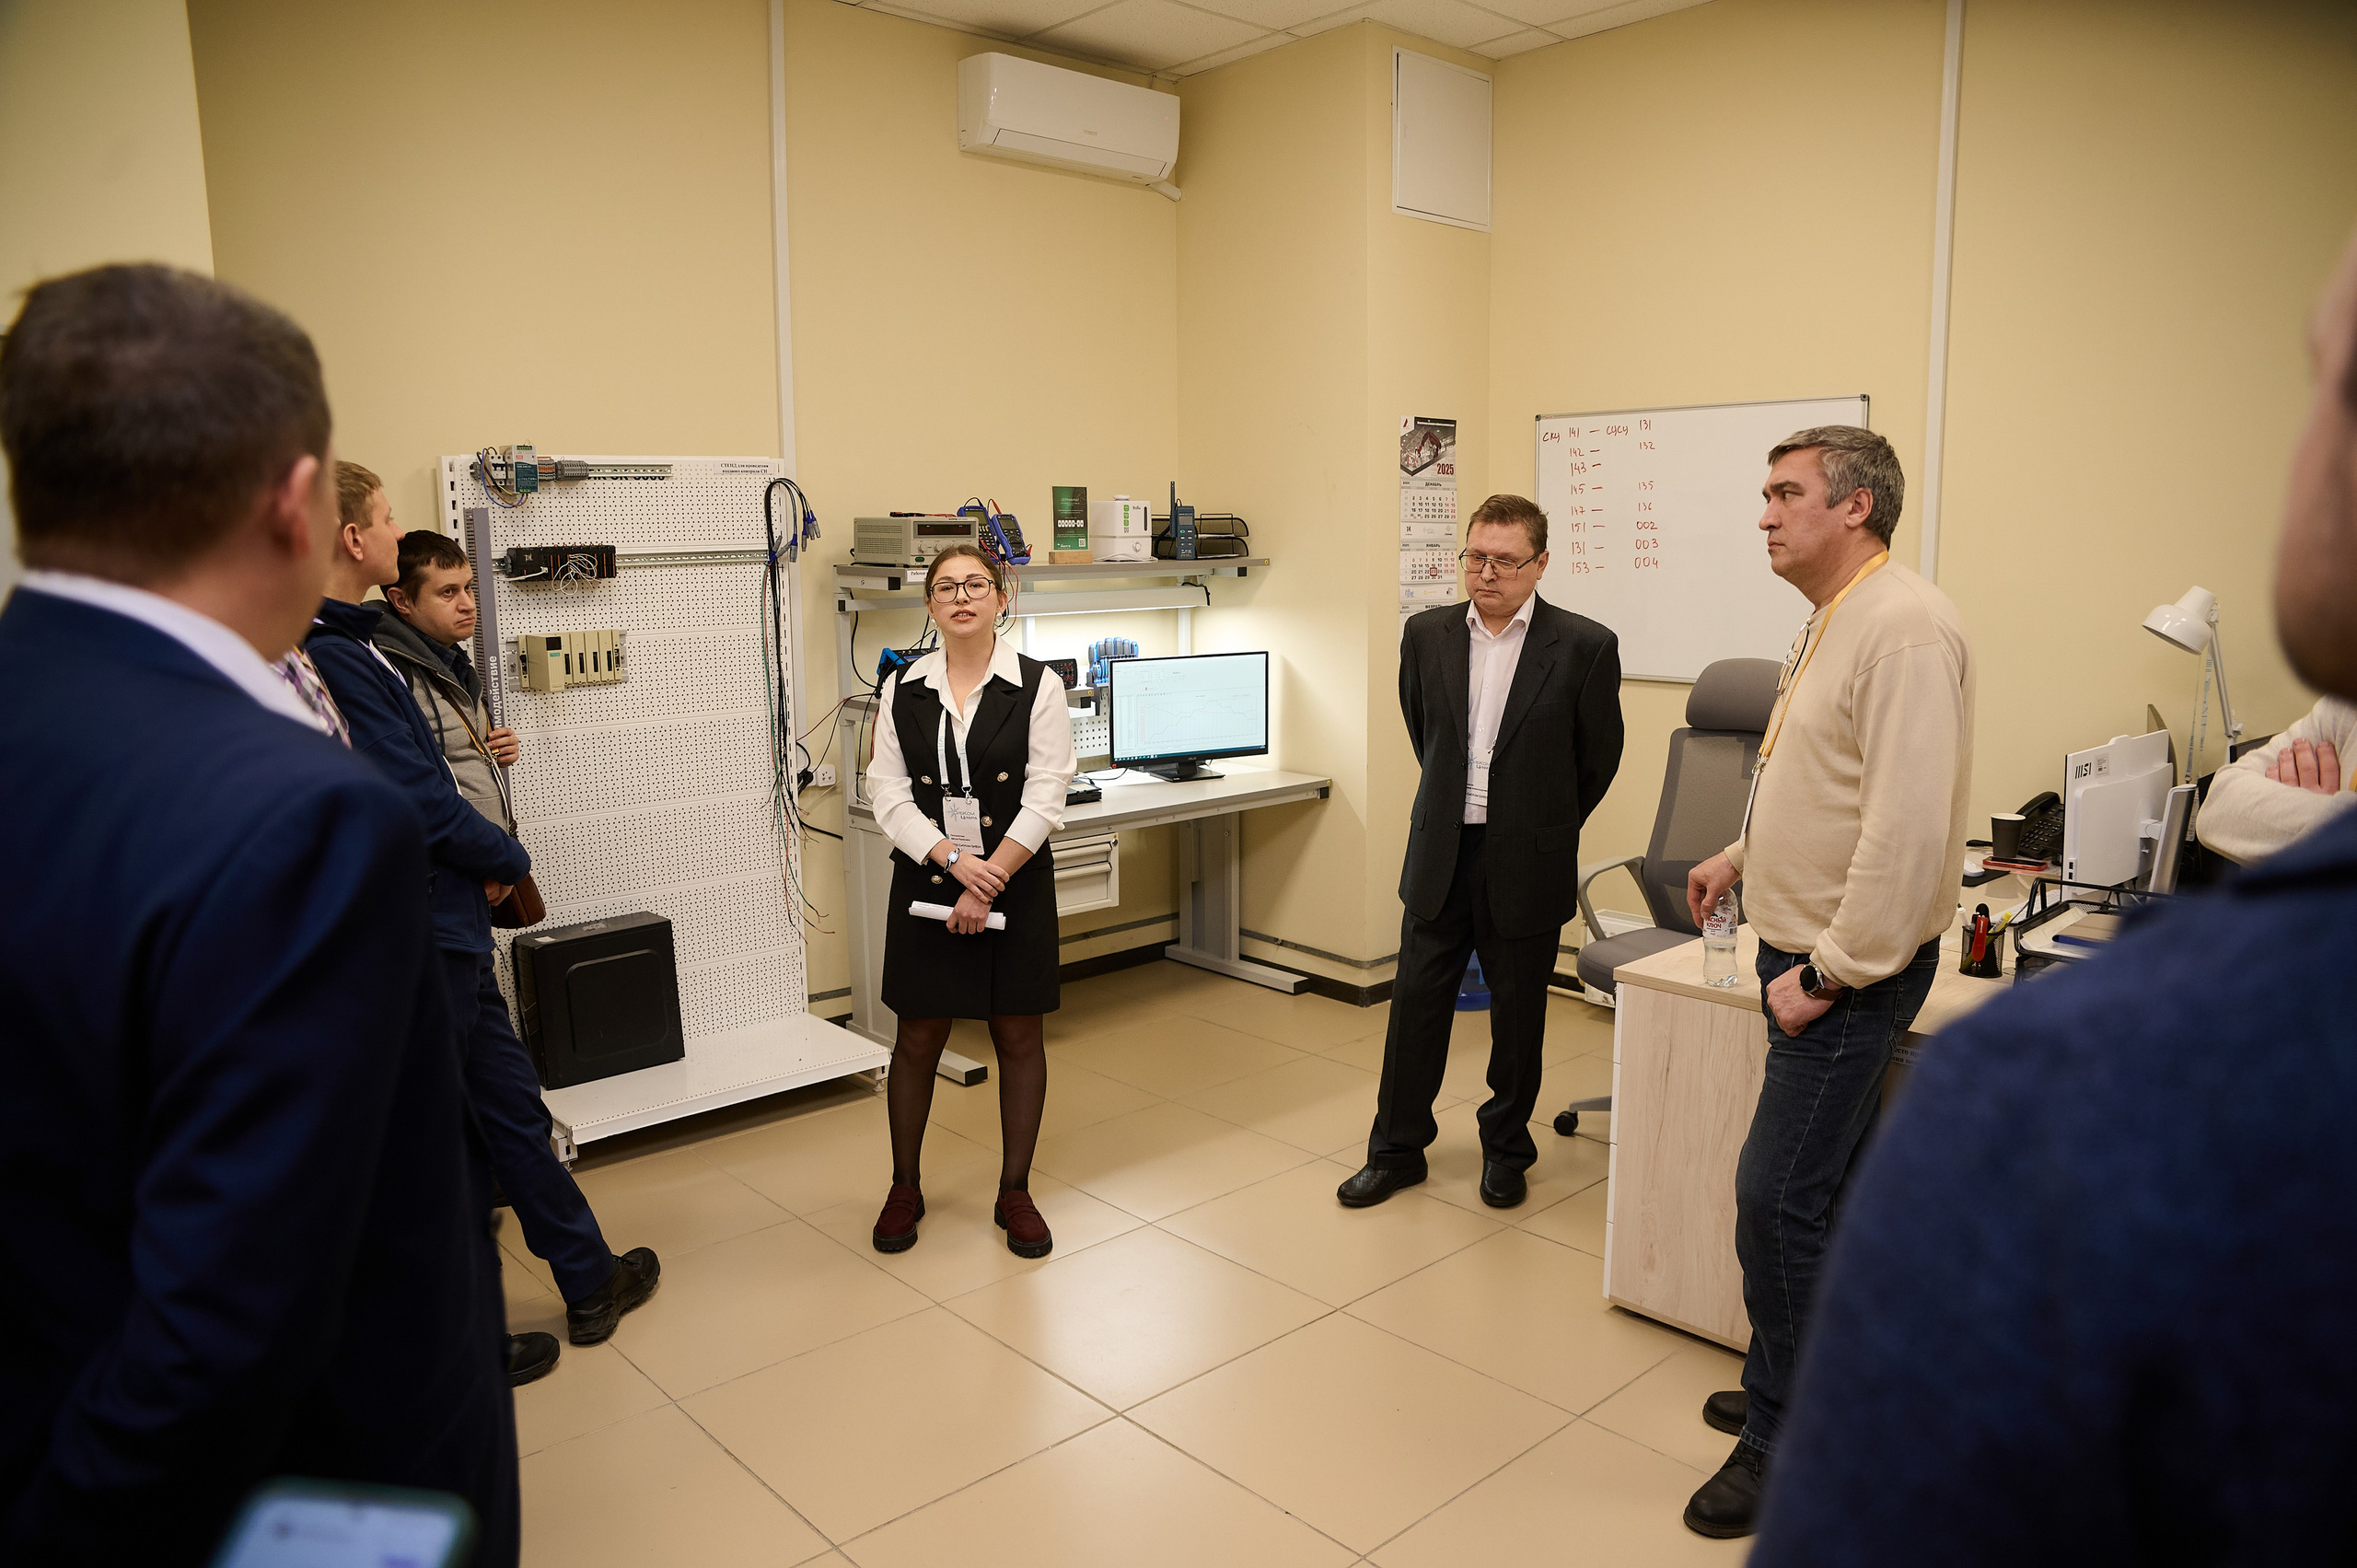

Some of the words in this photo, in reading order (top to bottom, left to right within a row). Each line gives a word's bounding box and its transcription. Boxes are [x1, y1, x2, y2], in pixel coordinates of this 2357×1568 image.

[1569, 427, 1579, 438] 141
[1640, 420, 1651, 431] 131
[1570, 447, 1585, 457] 142
[1437, 463, 1454, 475] 2025
[1571, 462, 1586, 476] 143
[1571, 483, 1585, 495] 145
[1638, 481, 1654, 491] 135
[1572, 505, 1585, 516] 147
[1638, 502, 1652, 512] 136
[1572, 522, 1585, 532] 151
[1636, 521, 1658, 529] 002
[1572, 541, 1585, 555] 131
[1635, 538, 1658, 550] 003
[1573, 562, 1590, 575] 153
[1634, 556, 1658, 569] 004
[489, 656, 503, 728] имодействие
[2075, 762, 2091, 779] MSI
